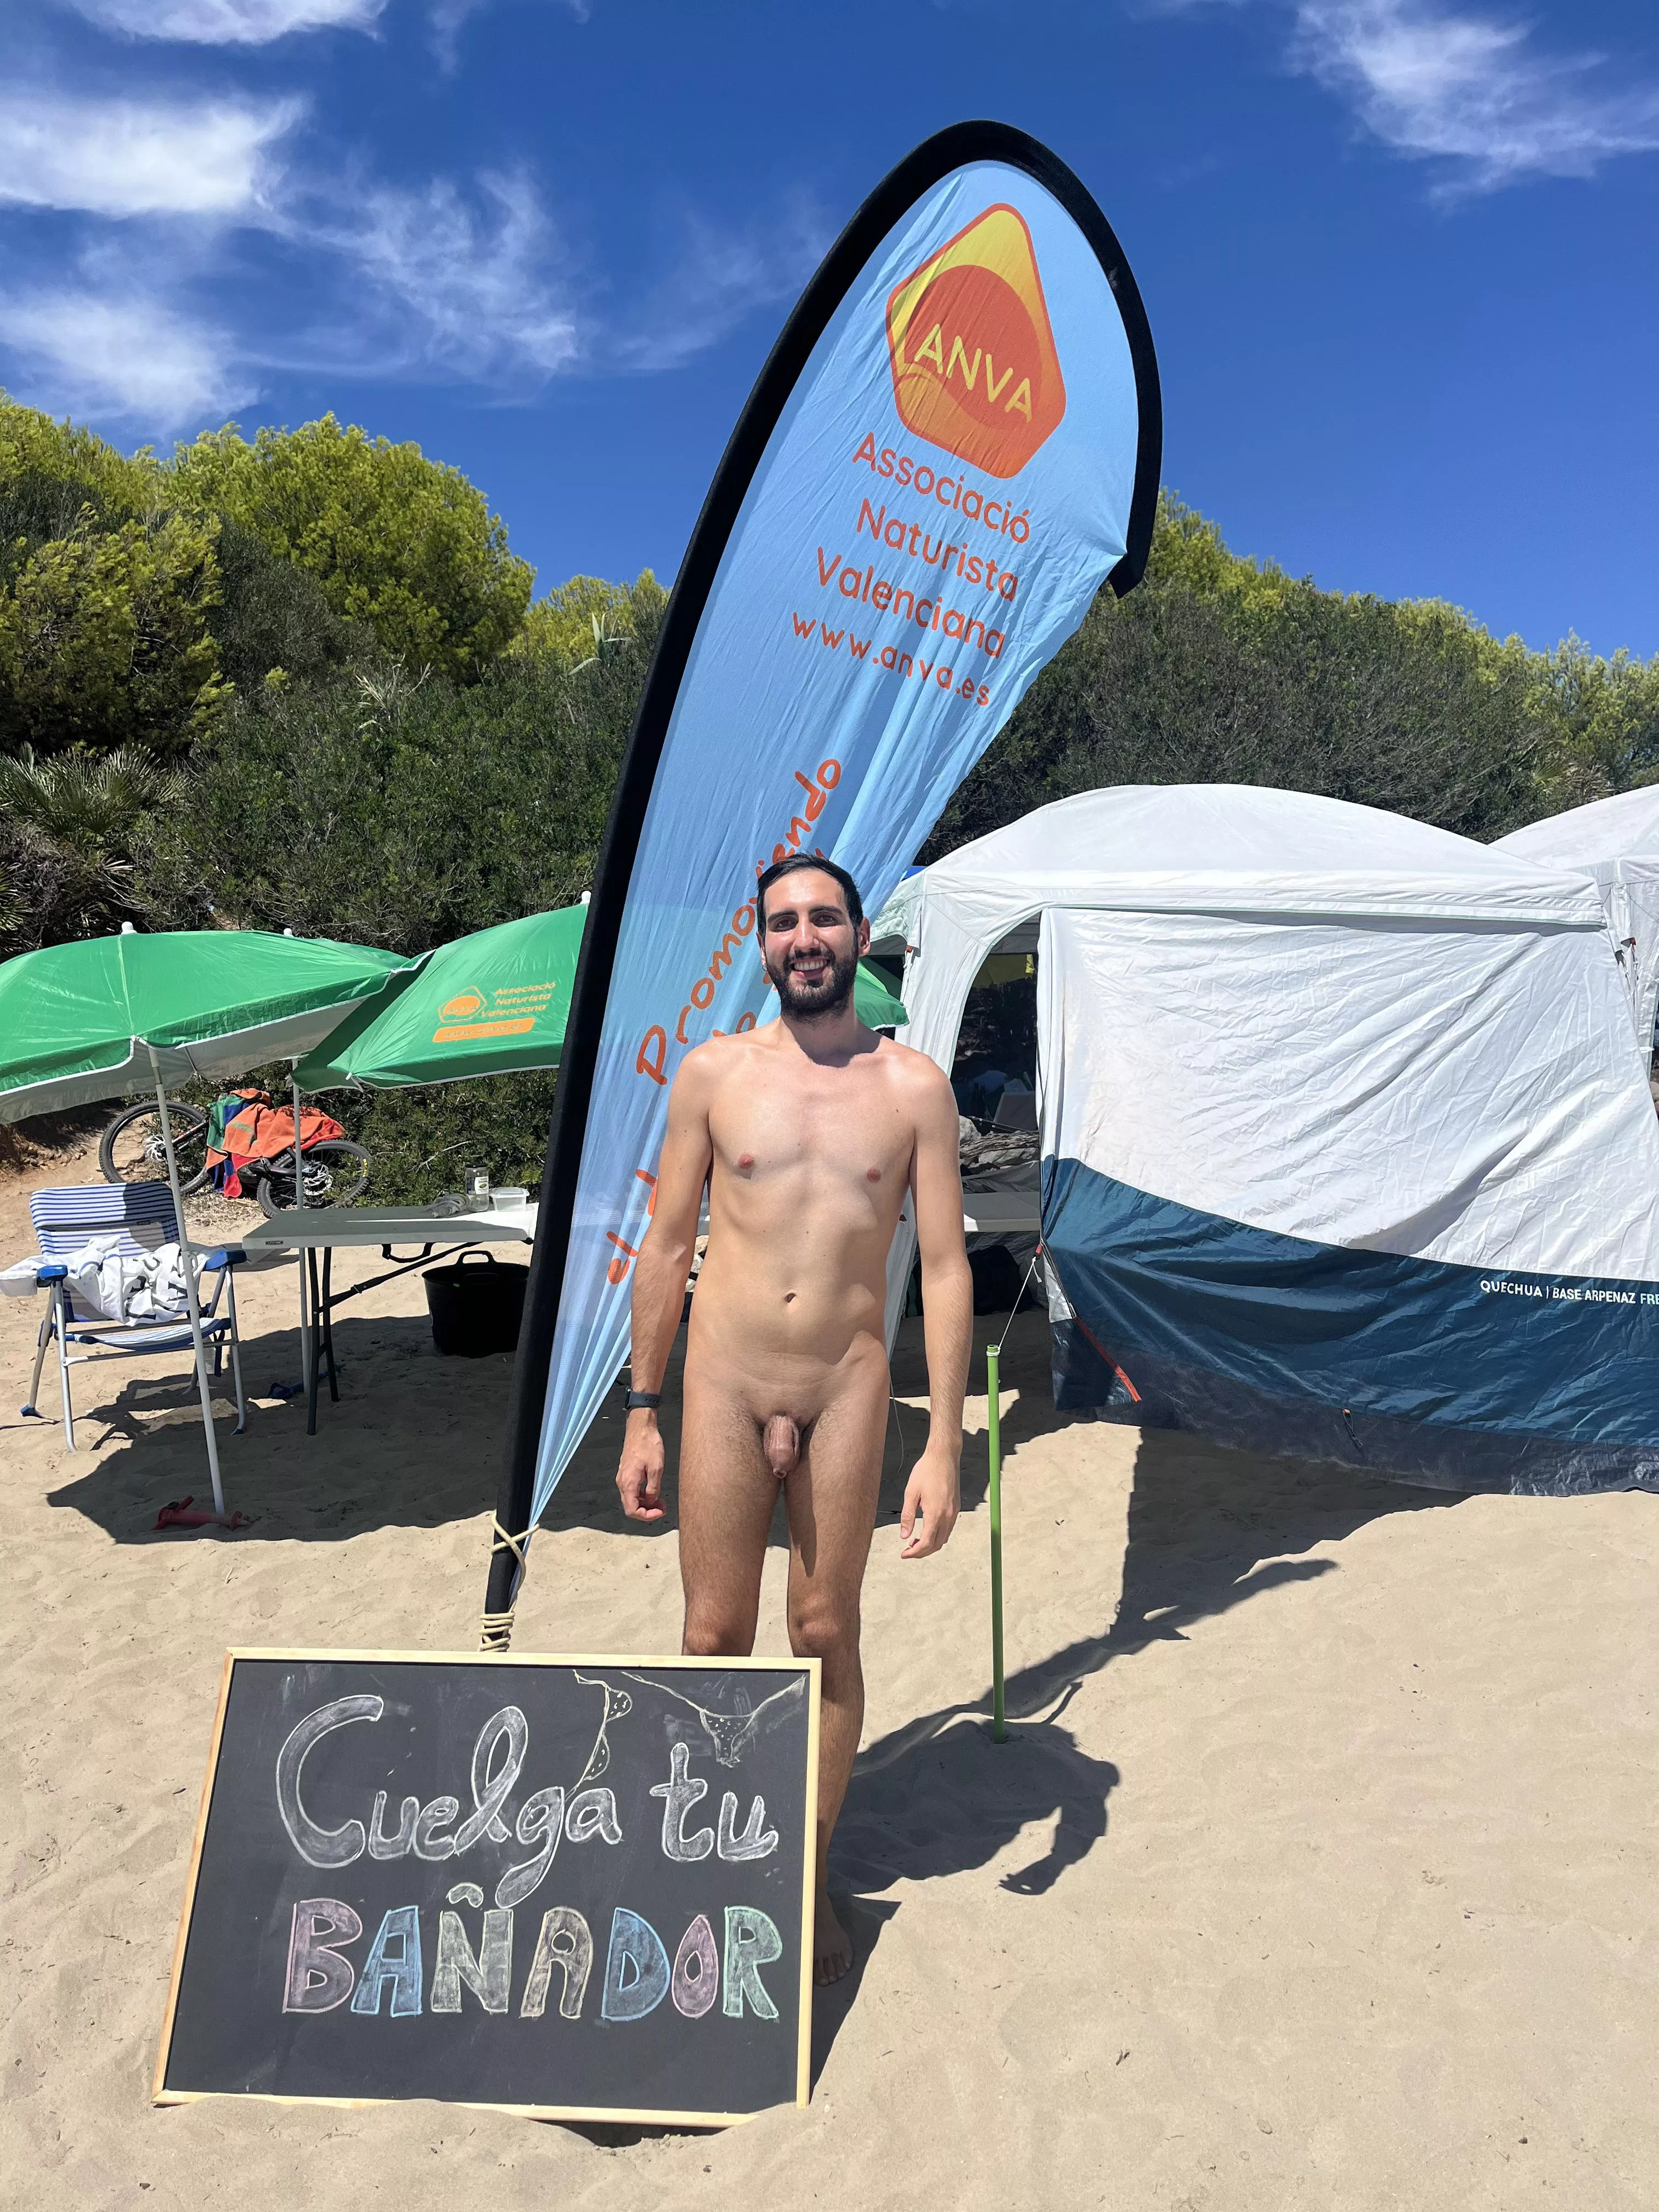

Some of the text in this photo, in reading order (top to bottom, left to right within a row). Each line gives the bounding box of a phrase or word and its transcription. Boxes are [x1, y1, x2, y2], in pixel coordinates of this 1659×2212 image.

[915, 323, 1032, 423] ANVA
[853, 432, 1030, 544] Associació
[856, 498, 1018, 601] Naturista
[817, 546, 1005, 658] Valenciana
[793, 613, 990, 707] www.anva.es
[482, 1005, 546, 1017] Valenciana
[495, 993, 551, 1005] Naturista
[1480, 1280, 1543, 1297] QUECHUA
[1552, 1287, 1582, 1300] BASE
[1584, 1289, 1637, 1304] ARPENAZ
[275, 1695, 779, 1908] Cuelga tu
[282, 1882, 783, 2022] BAÑADOR
